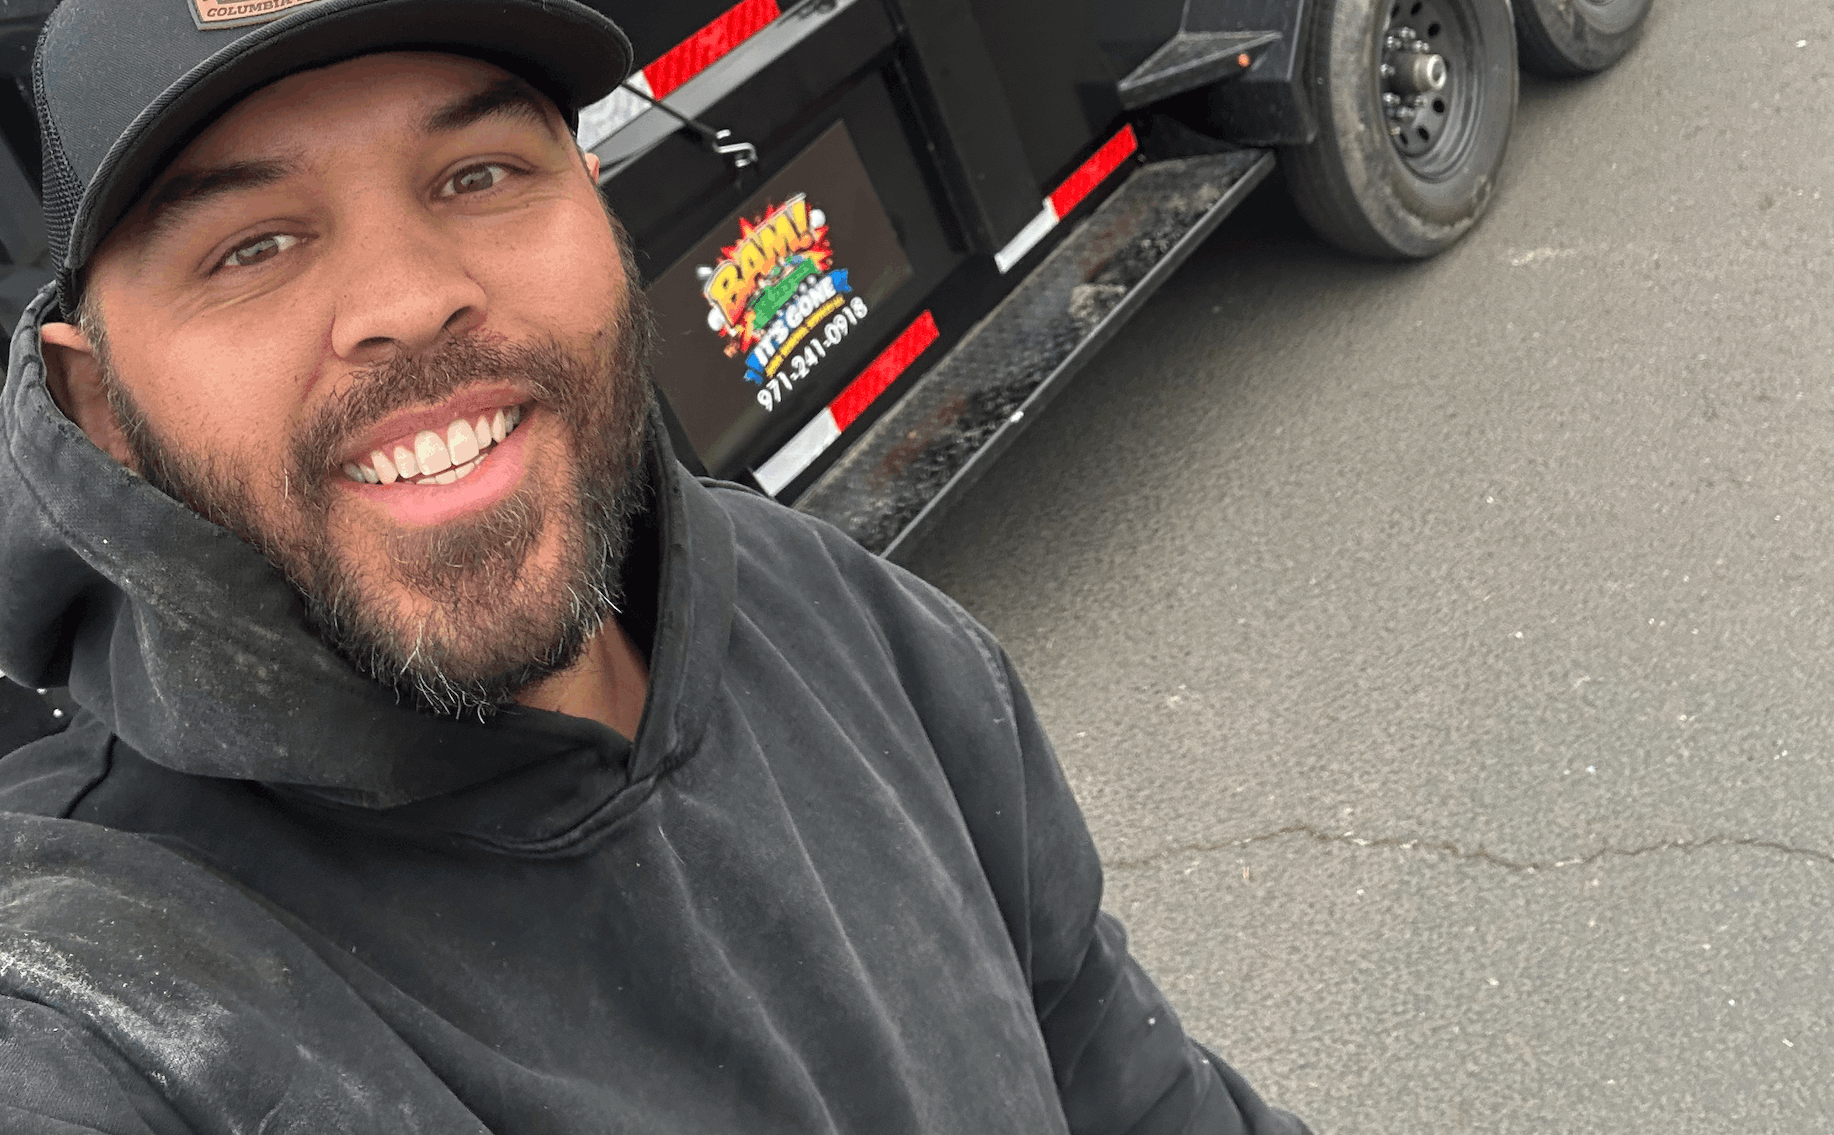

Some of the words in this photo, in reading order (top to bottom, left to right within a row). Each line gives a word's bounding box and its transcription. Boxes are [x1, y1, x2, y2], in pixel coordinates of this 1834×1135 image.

[705, 193, 813, 327] BAM!
[786, 276, 836, 328] GONE
[757, 296, 868, 412] 971-241-0918
